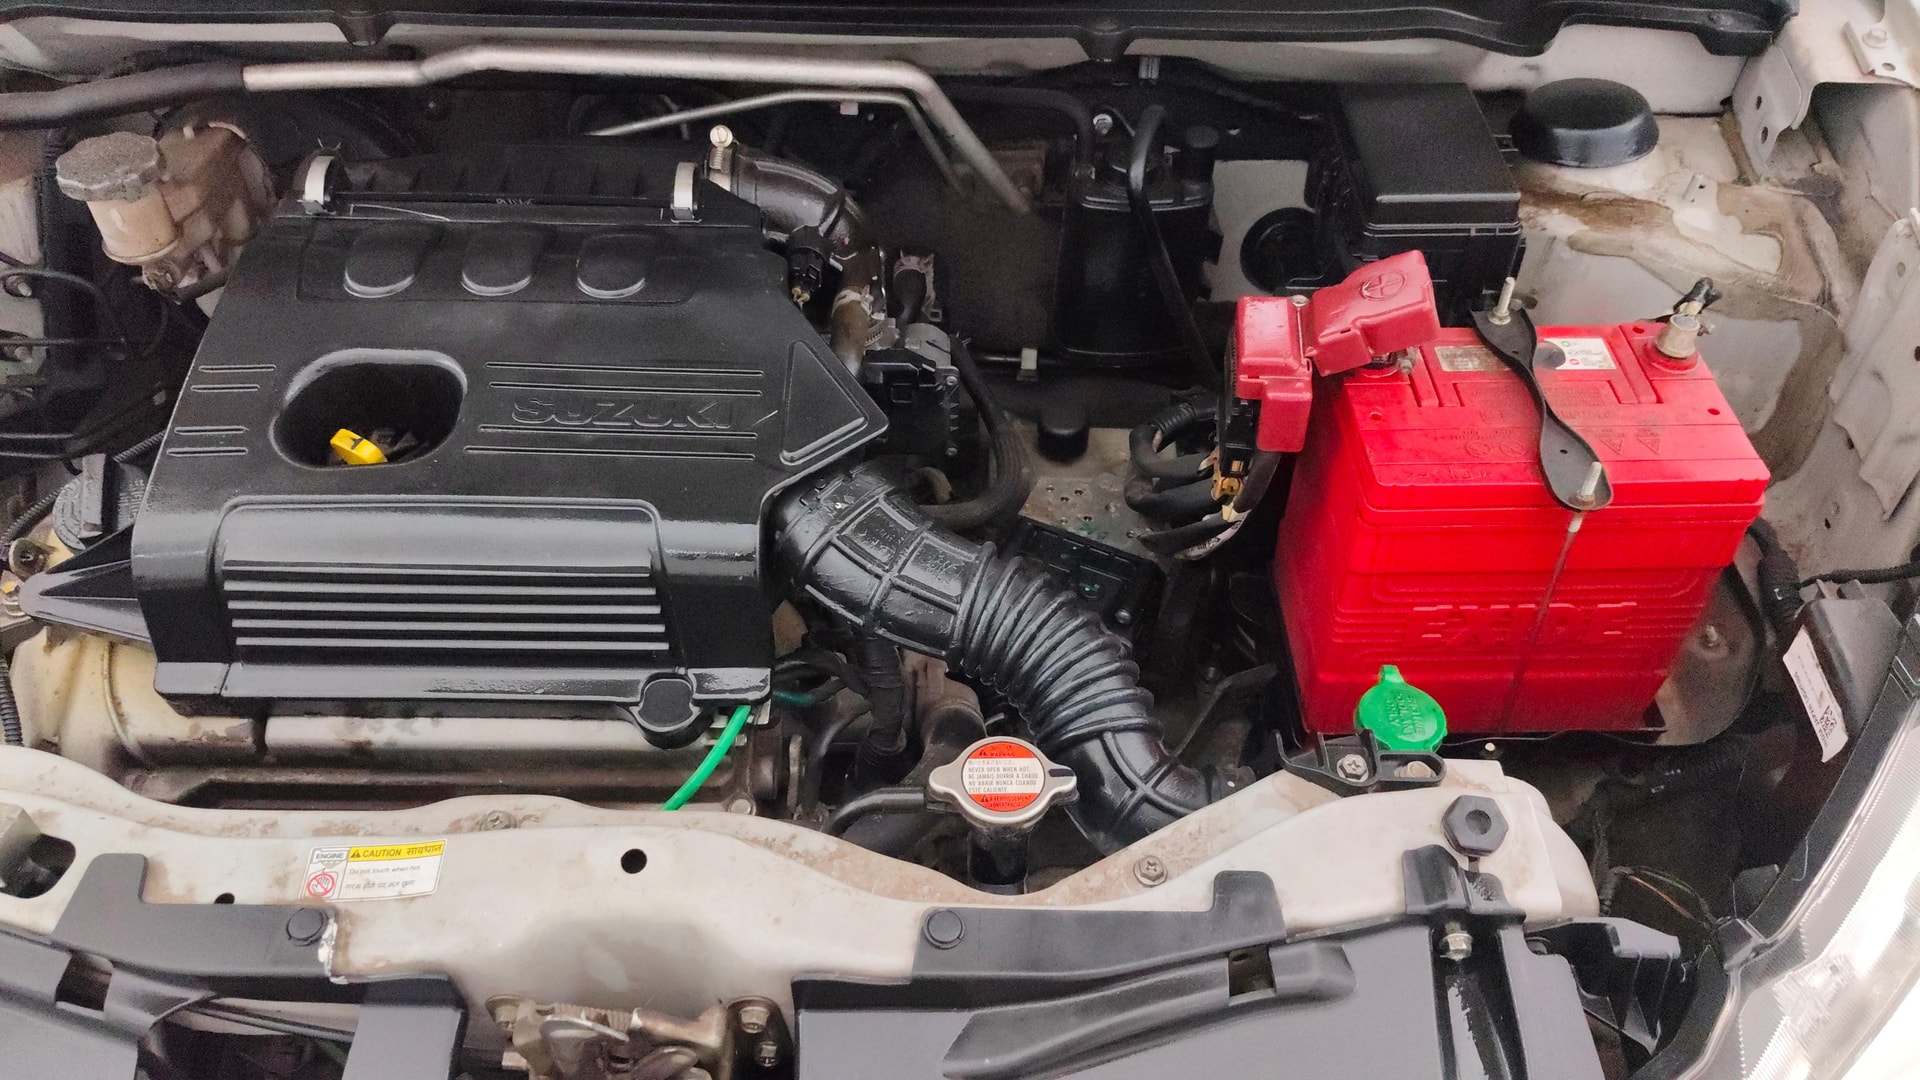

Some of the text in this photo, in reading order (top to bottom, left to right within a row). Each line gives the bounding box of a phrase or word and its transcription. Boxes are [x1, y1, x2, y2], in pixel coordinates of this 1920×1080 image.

[1404, 601, 1638, 647] EXIDE
[362, 849, 402, 857] CAUTION
[406, 844, 443, 855] सावधान
[315, 852, 345, 860] ENGINE
[372, 866, 390, 874] touch
